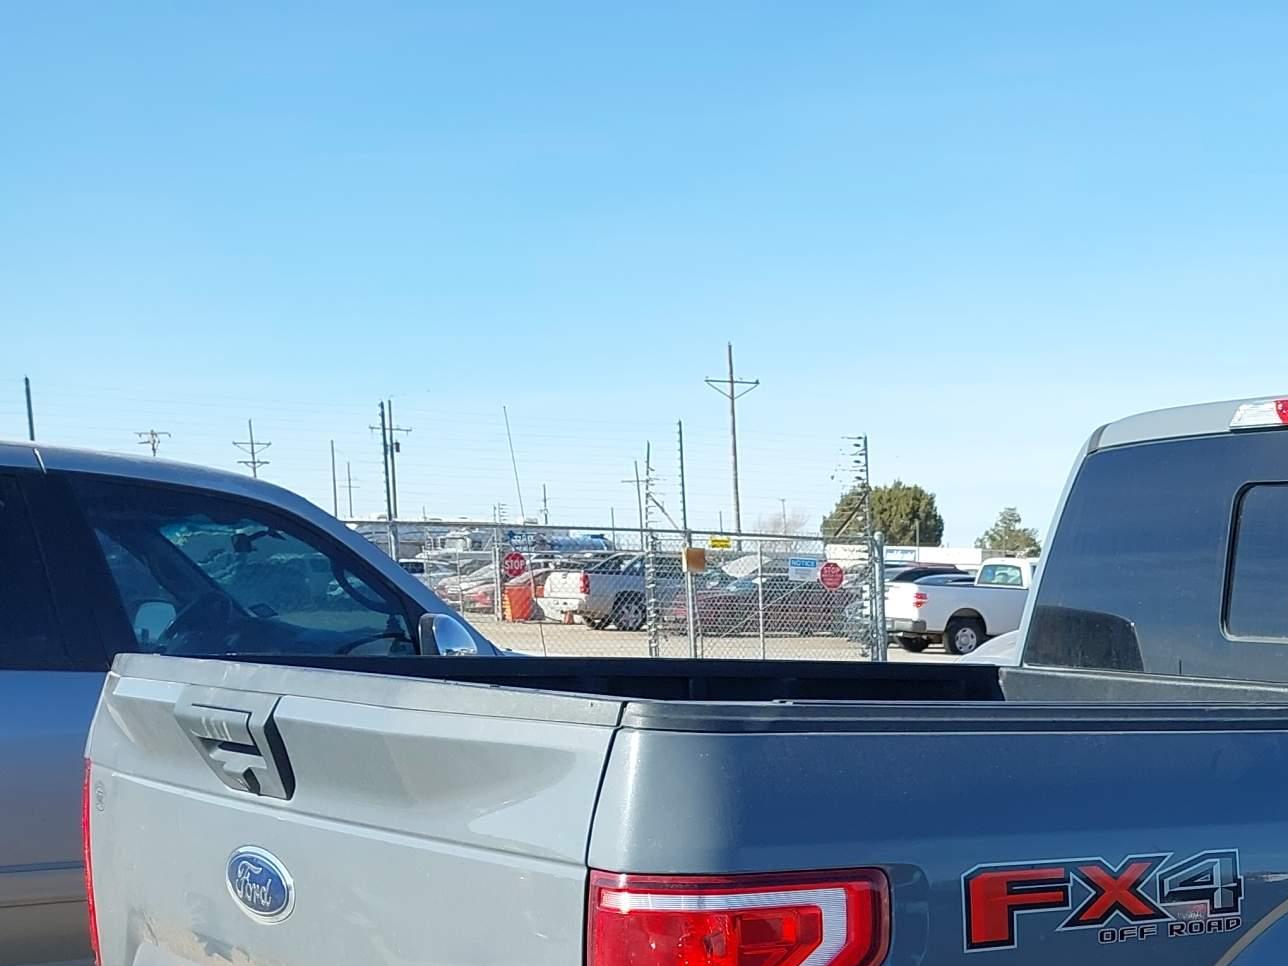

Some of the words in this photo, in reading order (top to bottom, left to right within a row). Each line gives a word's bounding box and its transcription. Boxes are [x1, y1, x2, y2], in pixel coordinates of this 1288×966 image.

[504, 559, 525, 569] STOP
[235, 860, 273, 907] Ford
[961, 848, 1245, 953] FX4
[1098, 923, 1158, 944] OFF
[1167, 915, 1243, 938] ROAD
